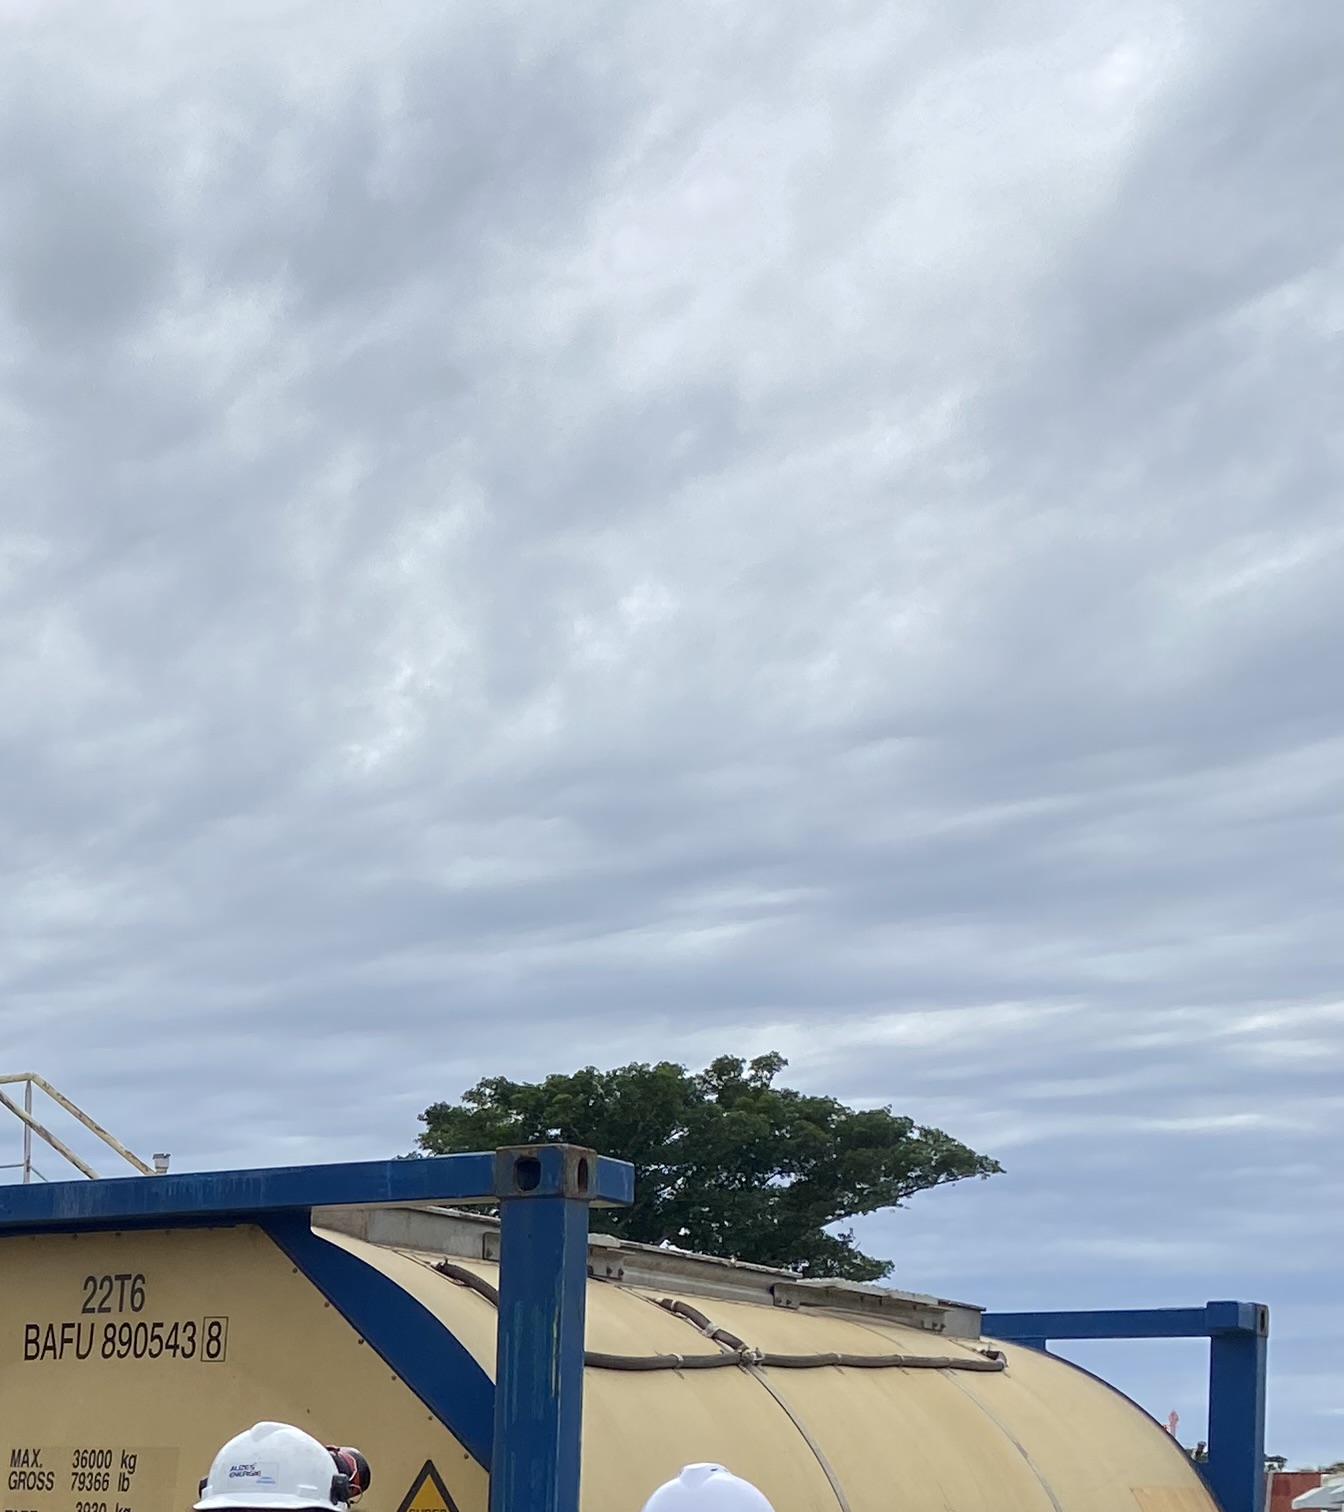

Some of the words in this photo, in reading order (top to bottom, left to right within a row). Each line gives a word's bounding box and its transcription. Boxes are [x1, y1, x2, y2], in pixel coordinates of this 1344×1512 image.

[81, 1274, 146, 1314] 22T6
[23, 1322, 95, 1361] BAFU
[101, 1320, 197, 1359] 890543
[206, 1320, 223, 1359] 8
[9, 1449, 43, 1468] MAX.
[72, 1449, 113, 1469] 36000
[120, 1449, 137, 1475] kg
[8, 1471, 55, 1490] GROSS
[71, 1472, 110, 1492] 79366
[118, 1473, 130, 1492] lb
